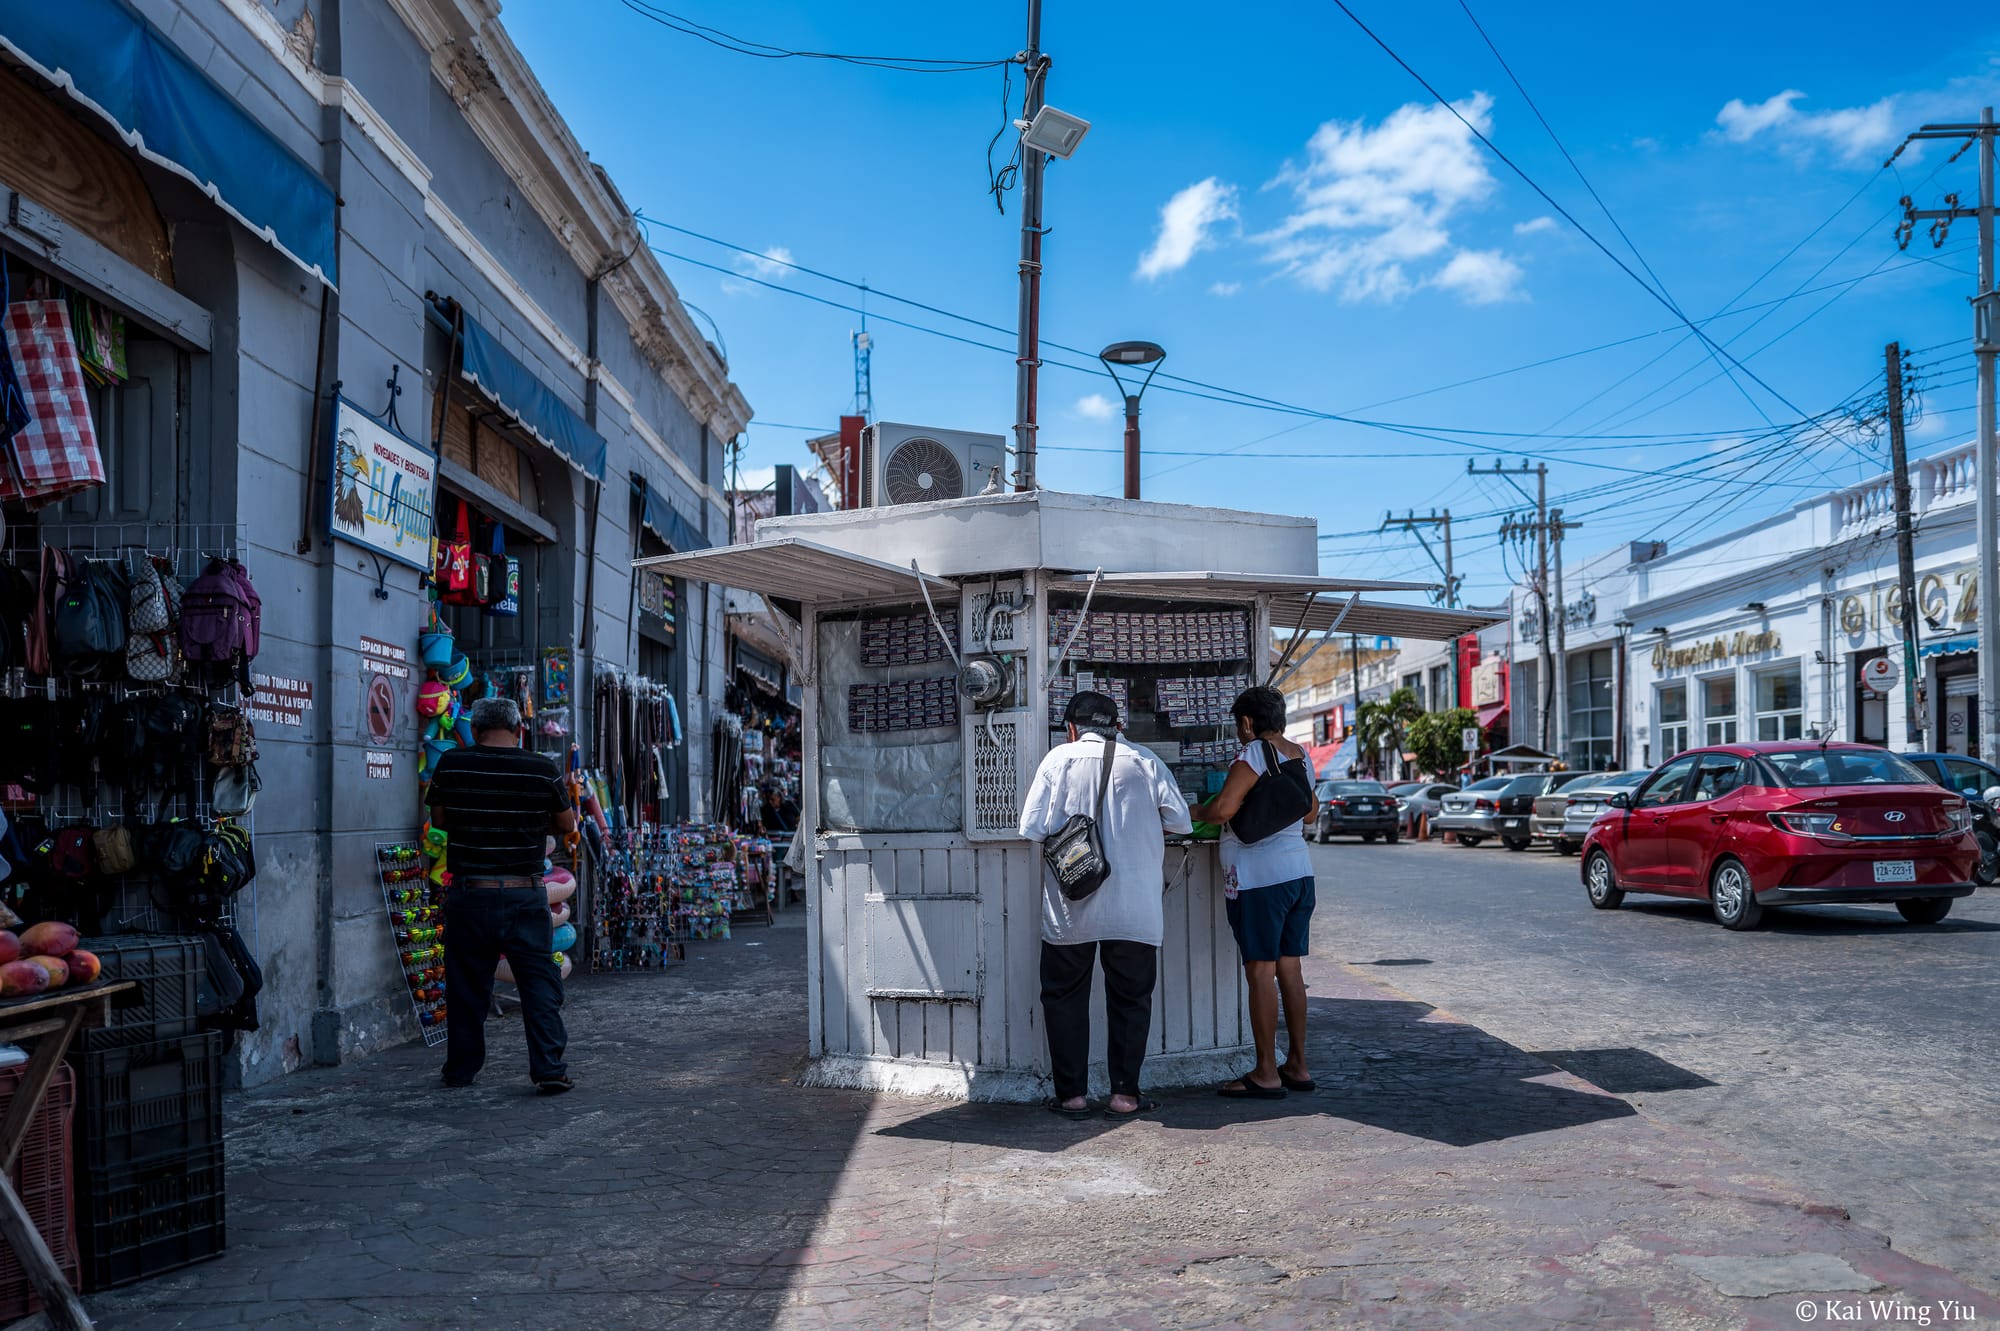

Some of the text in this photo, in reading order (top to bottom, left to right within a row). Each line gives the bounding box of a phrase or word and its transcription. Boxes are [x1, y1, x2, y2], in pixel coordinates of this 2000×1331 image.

[373, 442, 430, 481] NOVEDADES Y BISUTERIA
[366, 459, 430, 546] El Aguila
[360, 639, 381, 655] ESPACIO
[392, 647, 405, 661] LIBRE
[363, 658, 370, 670] DE
[384, 663, 391, 675] DE
[271, 676, 290, 690] TOMAR
[290, 679, 298, 691] EN
[299, 681, 308, 693] LA
[284, 695, 292, 707] LA
[292, 697, 313, 710] VENTA
[245, 706, 273, 722] MENORES
[275, 711, 284, 723] DE
[366, 750, 392, 765] PROHIBIDO
[369, 765, 390, 779] FUMAR
[1875, 865, 1913, 876] YZA-223-F
